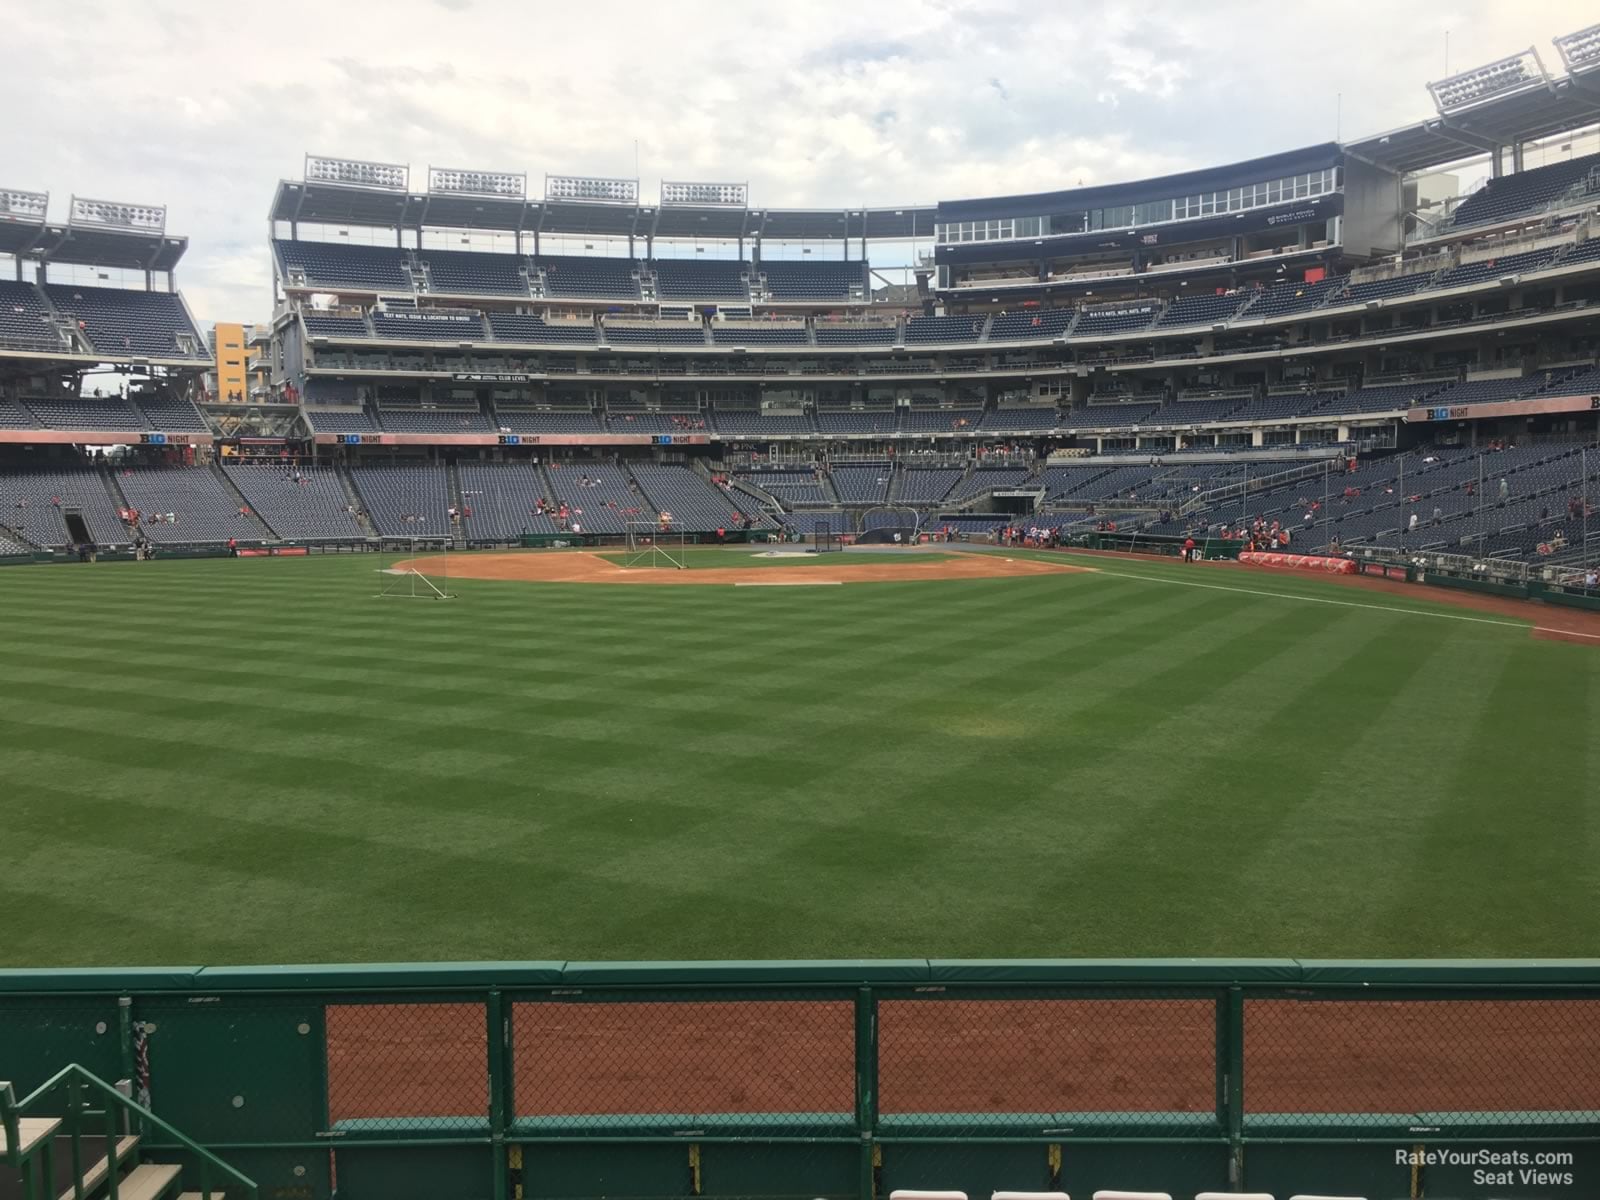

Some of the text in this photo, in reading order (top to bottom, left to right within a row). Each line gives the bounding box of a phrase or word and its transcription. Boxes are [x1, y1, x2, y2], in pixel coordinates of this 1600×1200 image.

[1449, 407, 1468, 418] NIGHT
[167, 435, 190, 443] NIGHT
[361, 435, 381, 443] NIGHT
